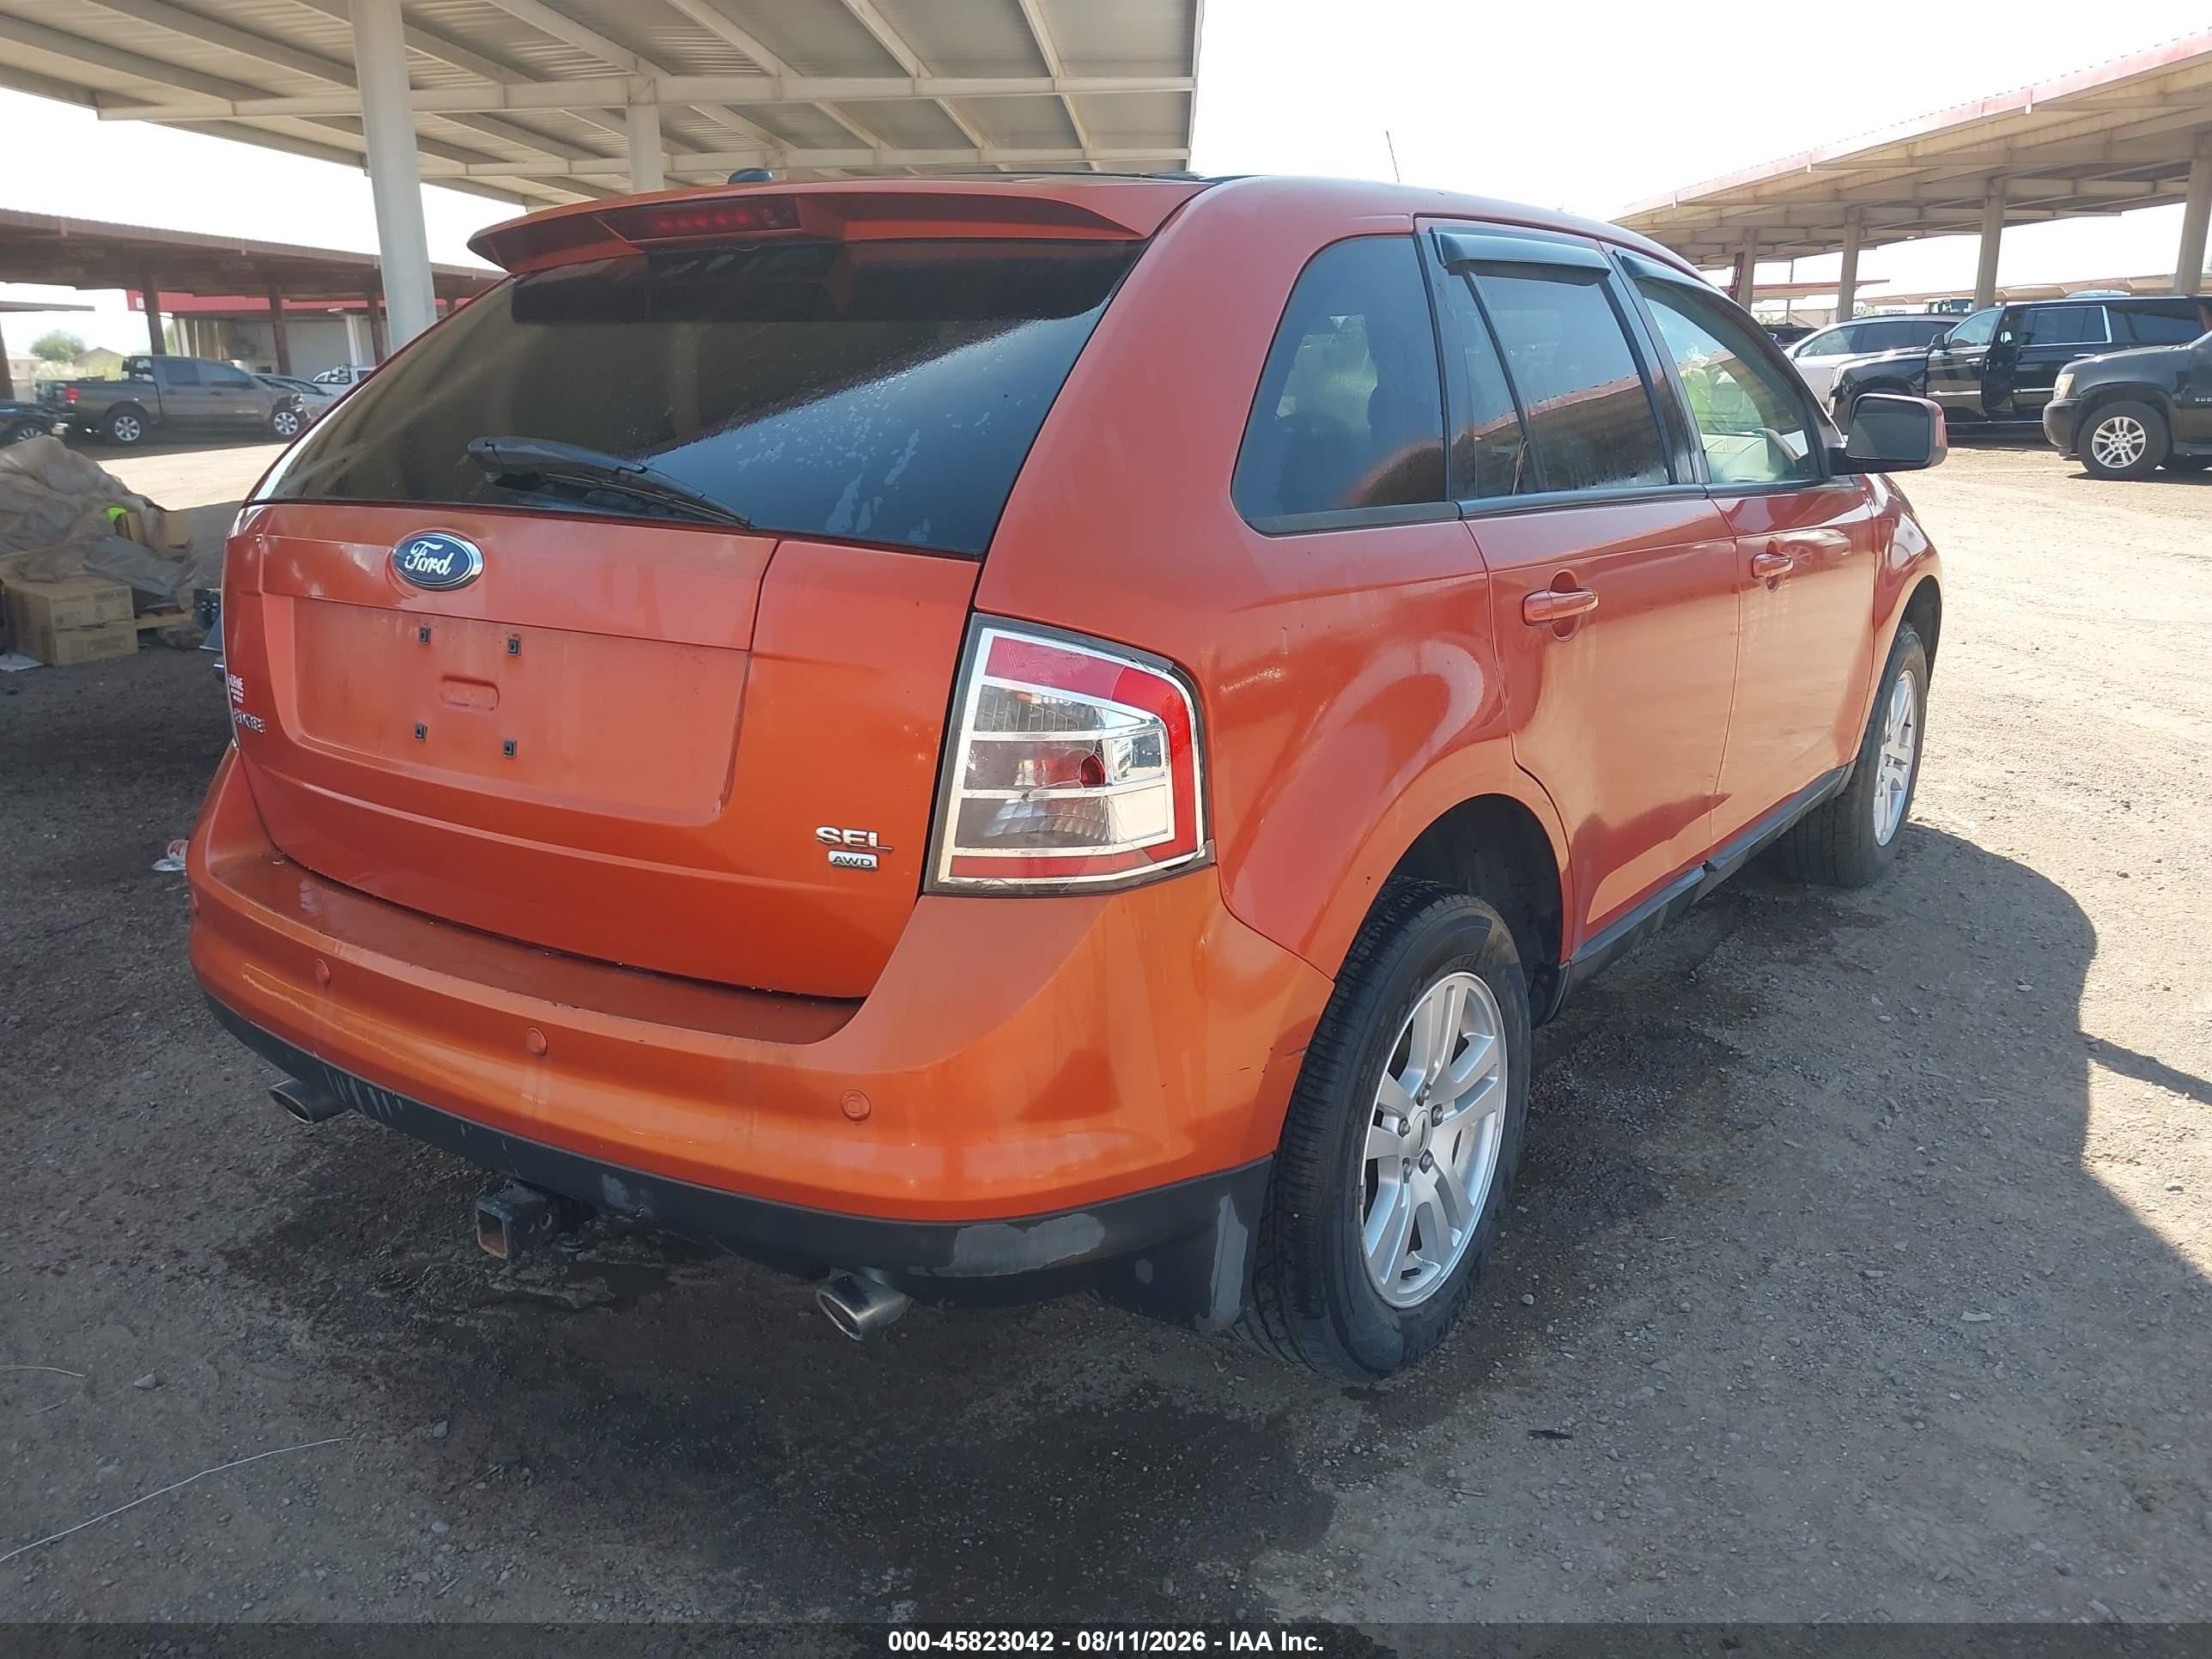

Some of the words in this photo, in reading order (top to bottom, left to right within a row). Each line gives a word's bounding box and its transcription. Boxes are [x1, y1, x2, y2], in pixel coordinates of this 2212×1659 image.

[404, 541, 455, 576] Ford
[815, 826, 894, 851] SEL
[833, 855, 873, 867] AWD
